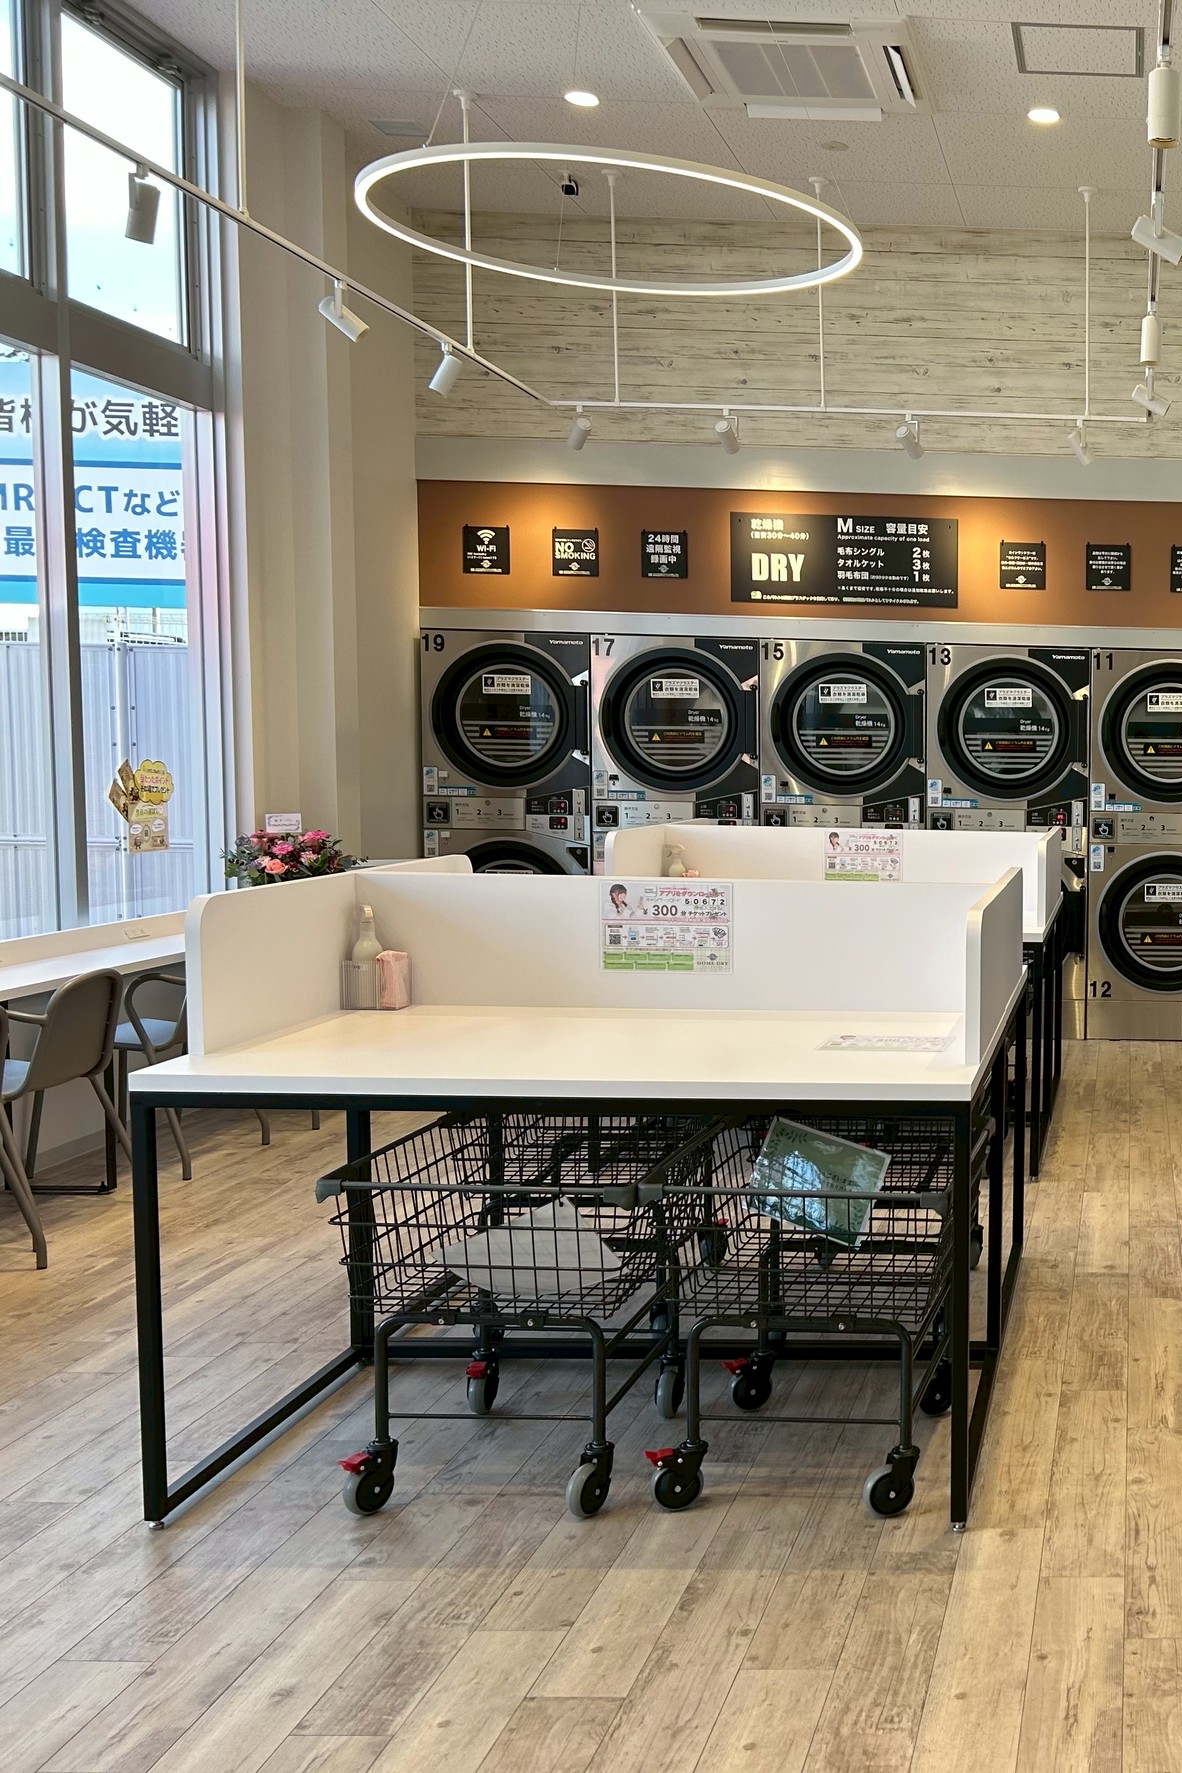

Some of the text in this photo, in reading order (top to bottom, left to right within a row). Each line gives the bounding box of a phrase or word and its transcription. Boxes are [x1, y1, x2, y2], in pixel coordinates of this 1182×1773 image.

[837, 518, 854, 533] M
[855, 525, 875, 534] SIZE
[886, 522, 929, 535] 容量目安
[647, 534, 679, 544] 24時間
[837, 534, 873, 542] Approximate
[874, 535, 898, 543] capacity
[555, 542, 574, 553] NO
[837, 547, 930, 558] 毛布シングル 2枚
[554, 551, 596, 561] SMOKING
[751, 552, 805, 582] DRY
[837, 559, 930, 571] タオルケット 3枚
[837, 571, 930, 582] 羽毛布団 1枚
[421, 633, 445, 652] 19
[592, 638, 615, 657] 17
[761, 642, 784, 661] 15
[928, 647, 952, 666] 13
[1093, 652, 1113, 671] 11
[854, 844, 870, 852] 300
[652, 904, 678, 916] 300
[1089, 980, 1112, 998] 12
